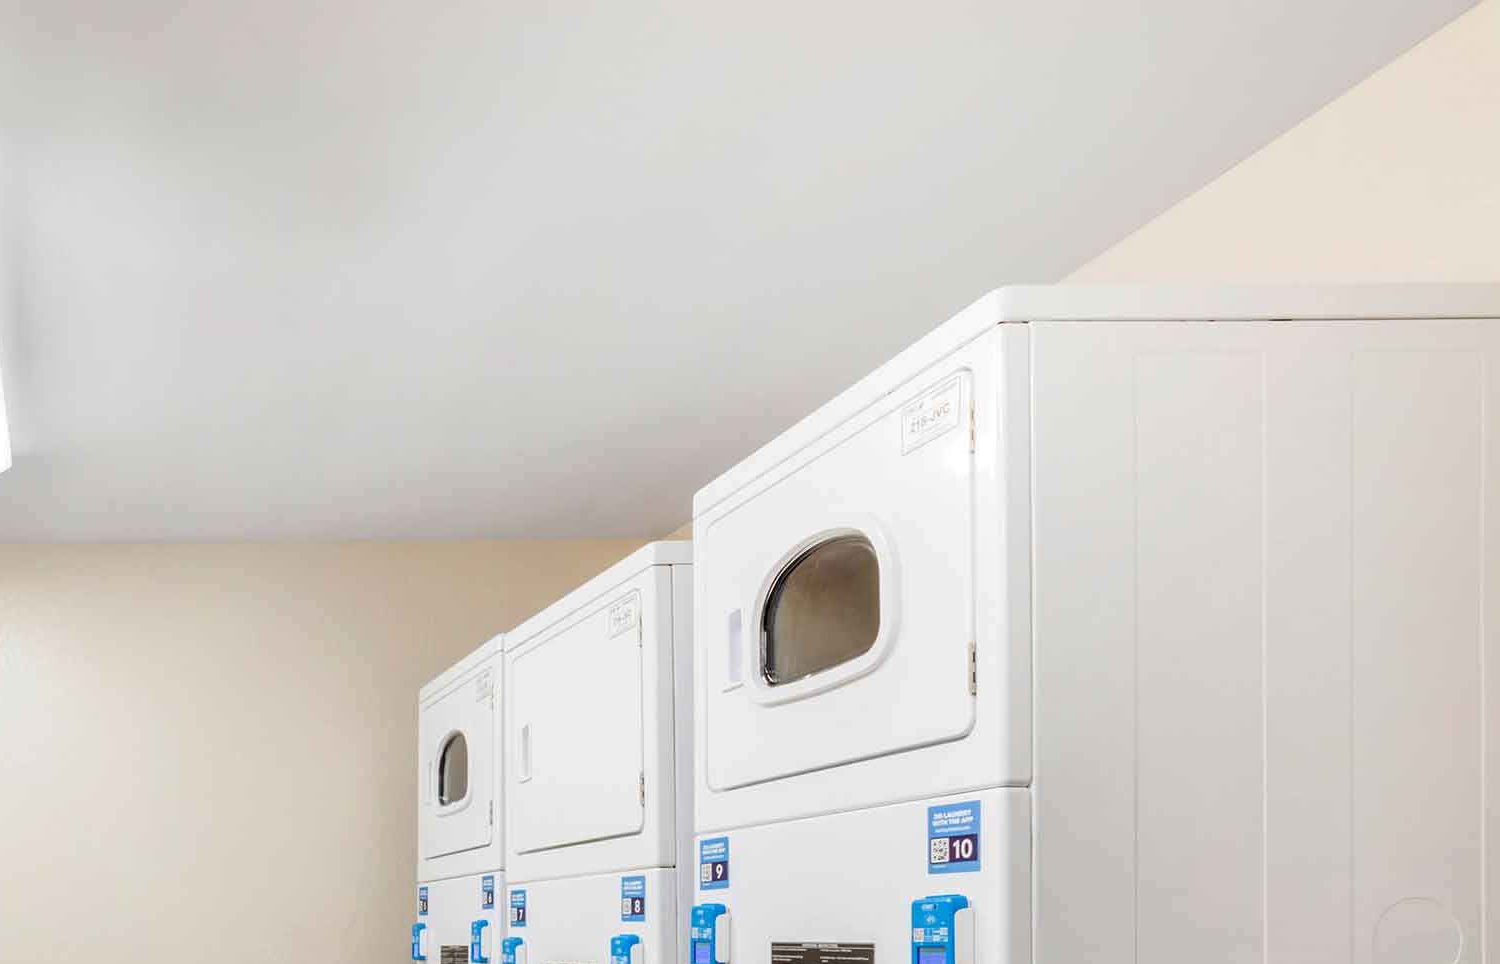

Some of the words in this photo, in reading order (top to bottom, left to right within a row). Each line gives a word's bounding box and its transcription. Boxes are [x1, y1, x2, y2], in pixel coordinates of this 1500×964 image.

[953, 838, 973, 859] 10
[715, 863, 723, 879] 9
[634, 899, 641, 913] 8
[519, 909, 524, 920] 7
